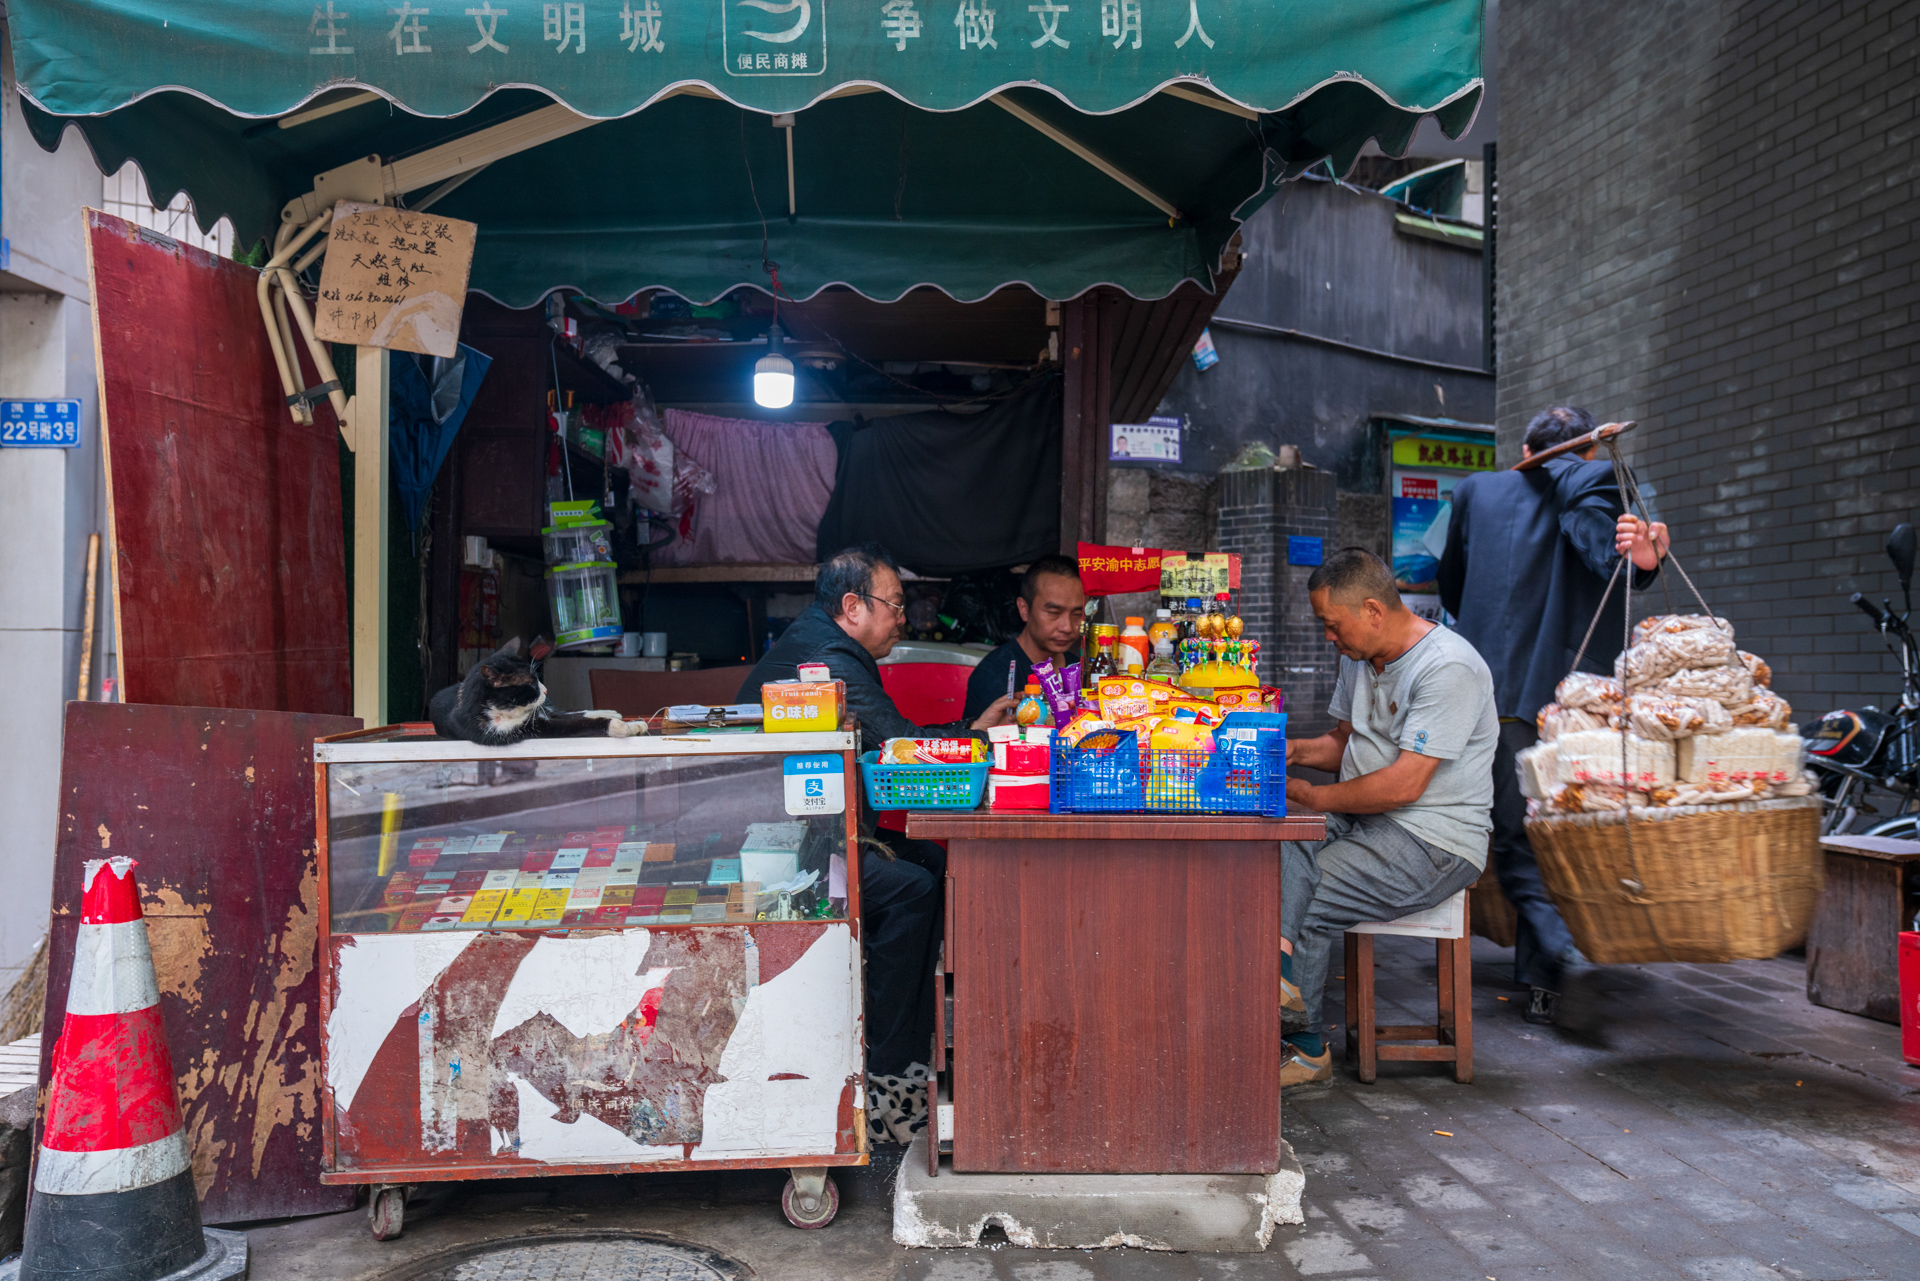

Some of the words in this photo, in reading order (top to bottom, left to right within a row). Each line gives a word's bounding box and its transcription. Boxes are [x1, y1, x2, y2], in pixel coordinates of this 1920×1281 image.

[737, 53, 808, 70] 便民商摊
[350, 252, 433, 275] 天然气灶
[376, 272, 416, 293] 维修
[3, 421, 75, 441] 22号附3号
[1078, 557, 1160, 572] 平安渝中志愿
[801, 690, 823, 698] candy
[771, 705, 819, 720] 6味棒
[796, 761, 829, 769] 推荐使用
[803, 797, 826, 806] 支付宝
